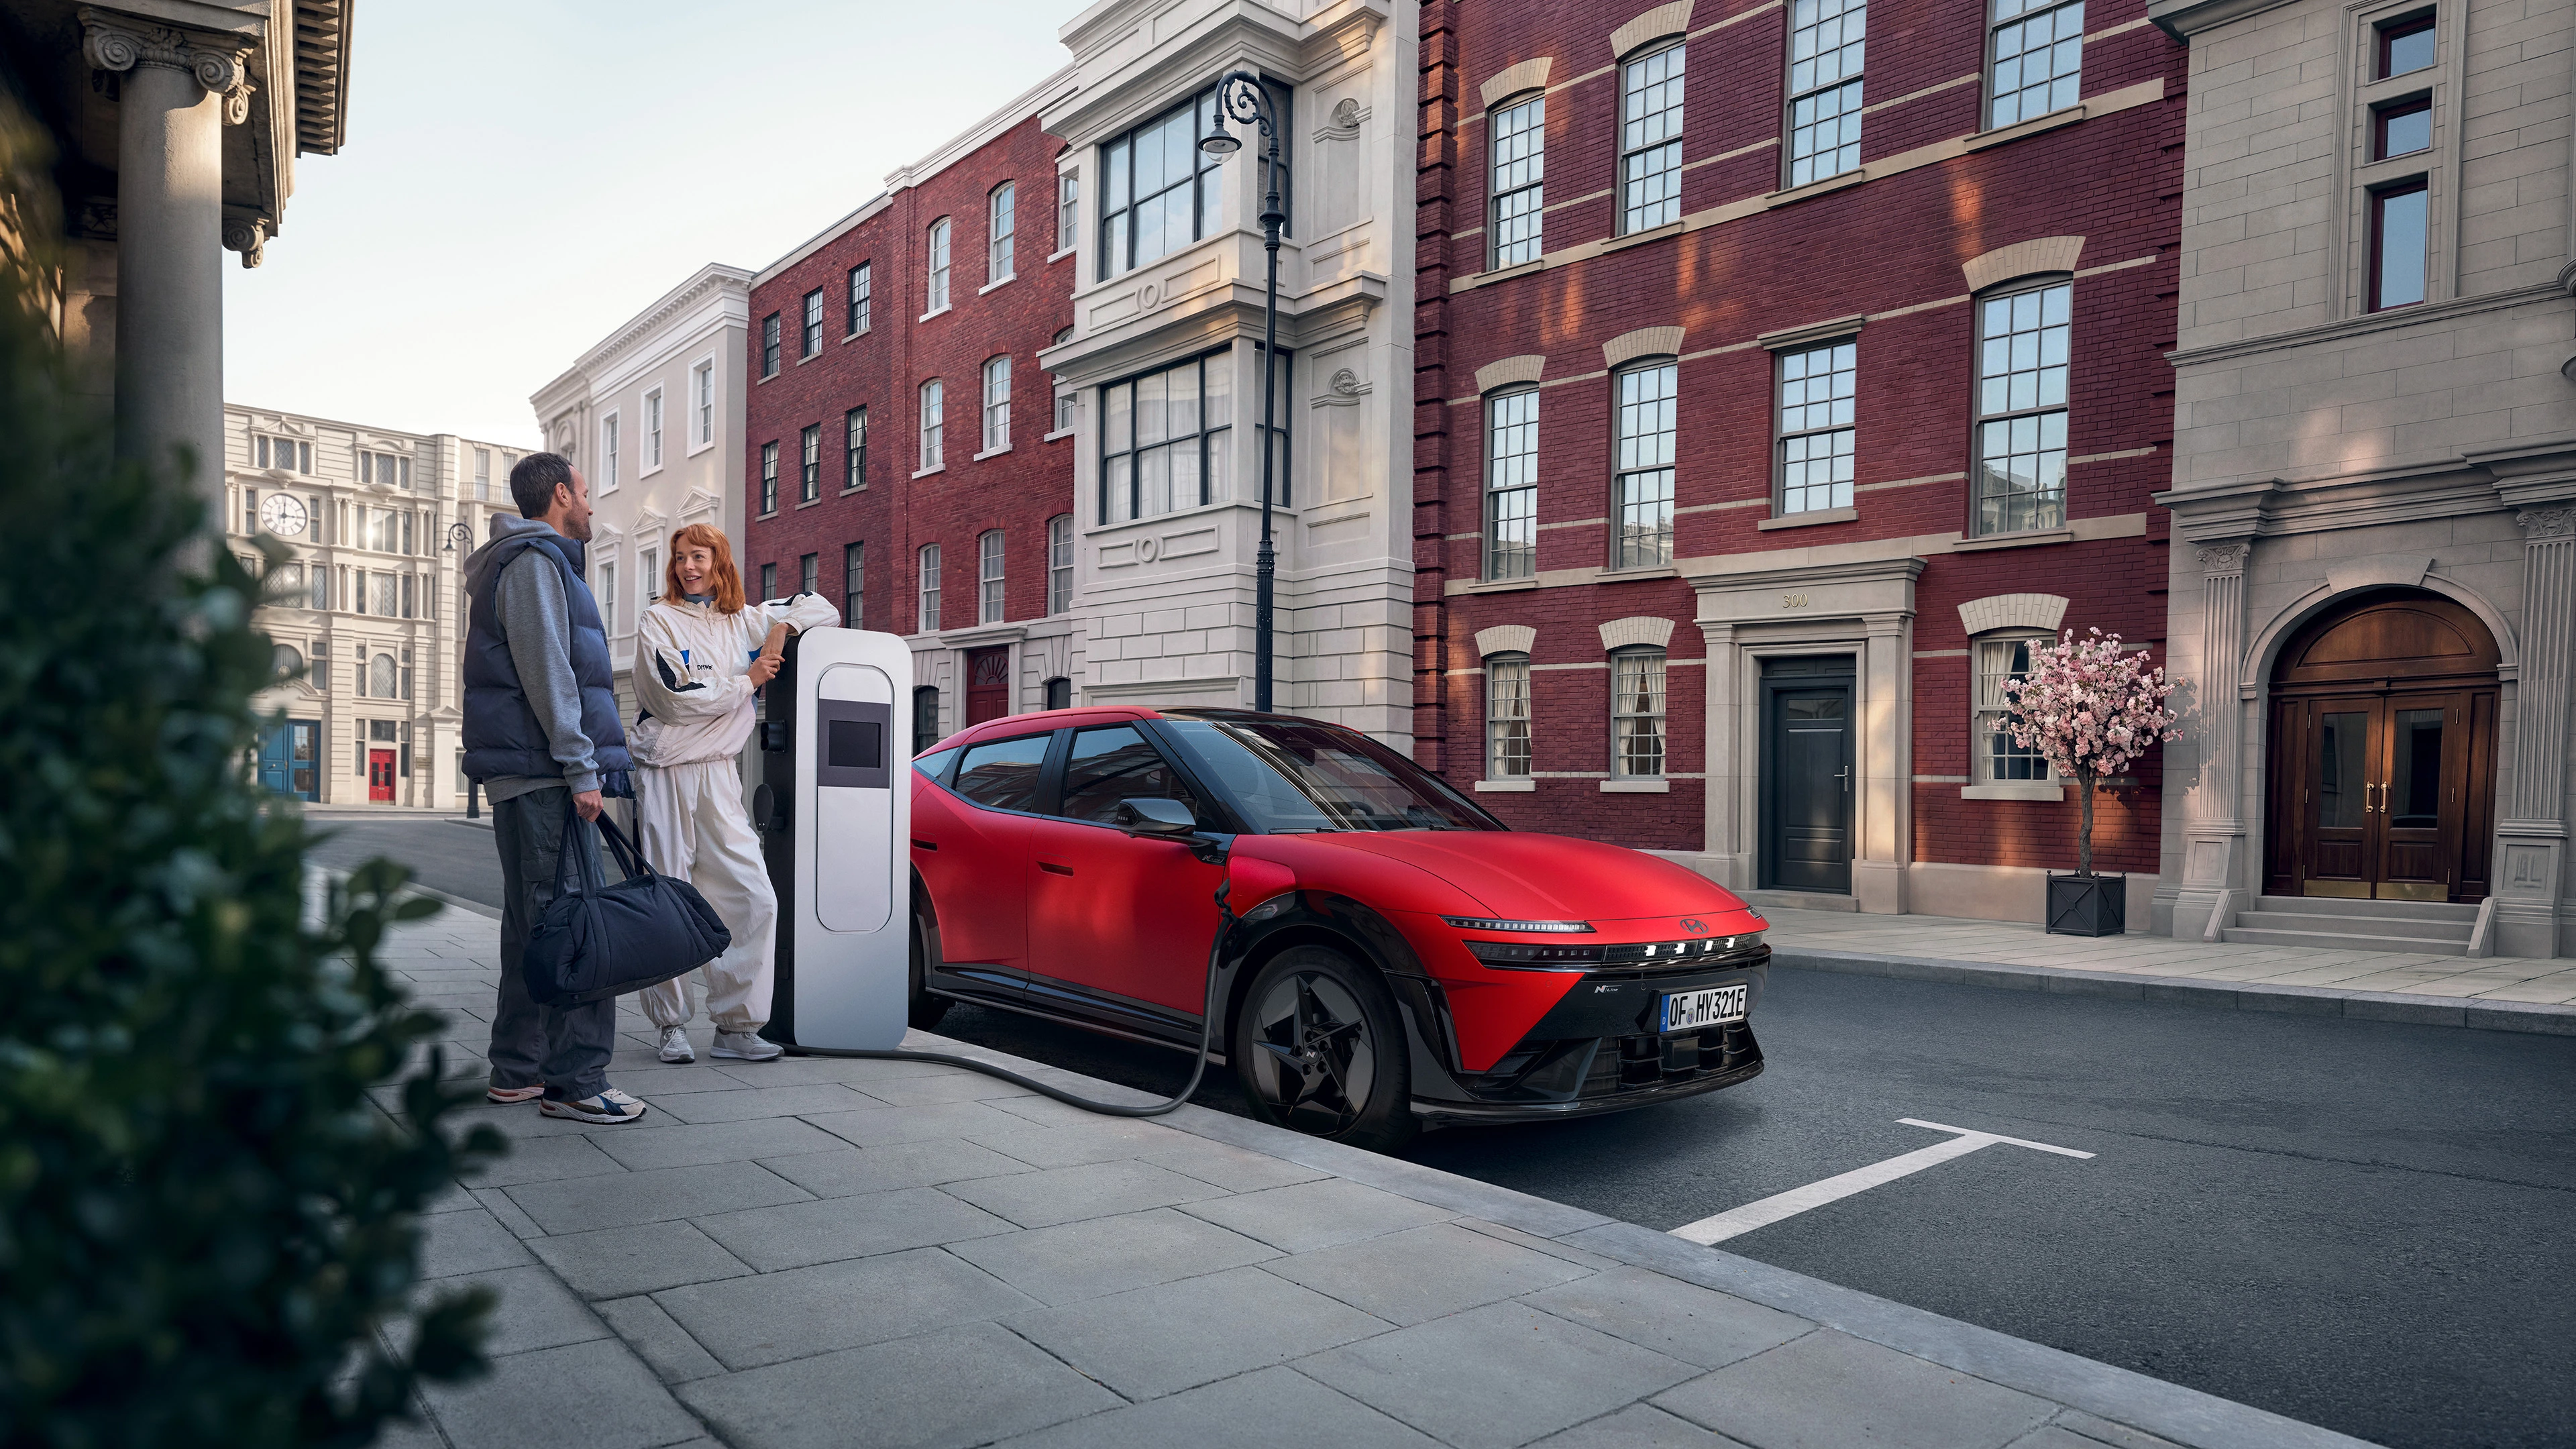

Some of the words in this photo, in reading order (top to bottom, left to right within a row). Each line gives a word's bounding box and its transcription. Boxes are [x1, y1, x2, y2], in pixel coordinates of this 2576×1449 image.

[1782, 593, 1808, 608] 300
[1670, 996, 1688, 1026] OF
[1662, 1016, 1666, 1025] D
